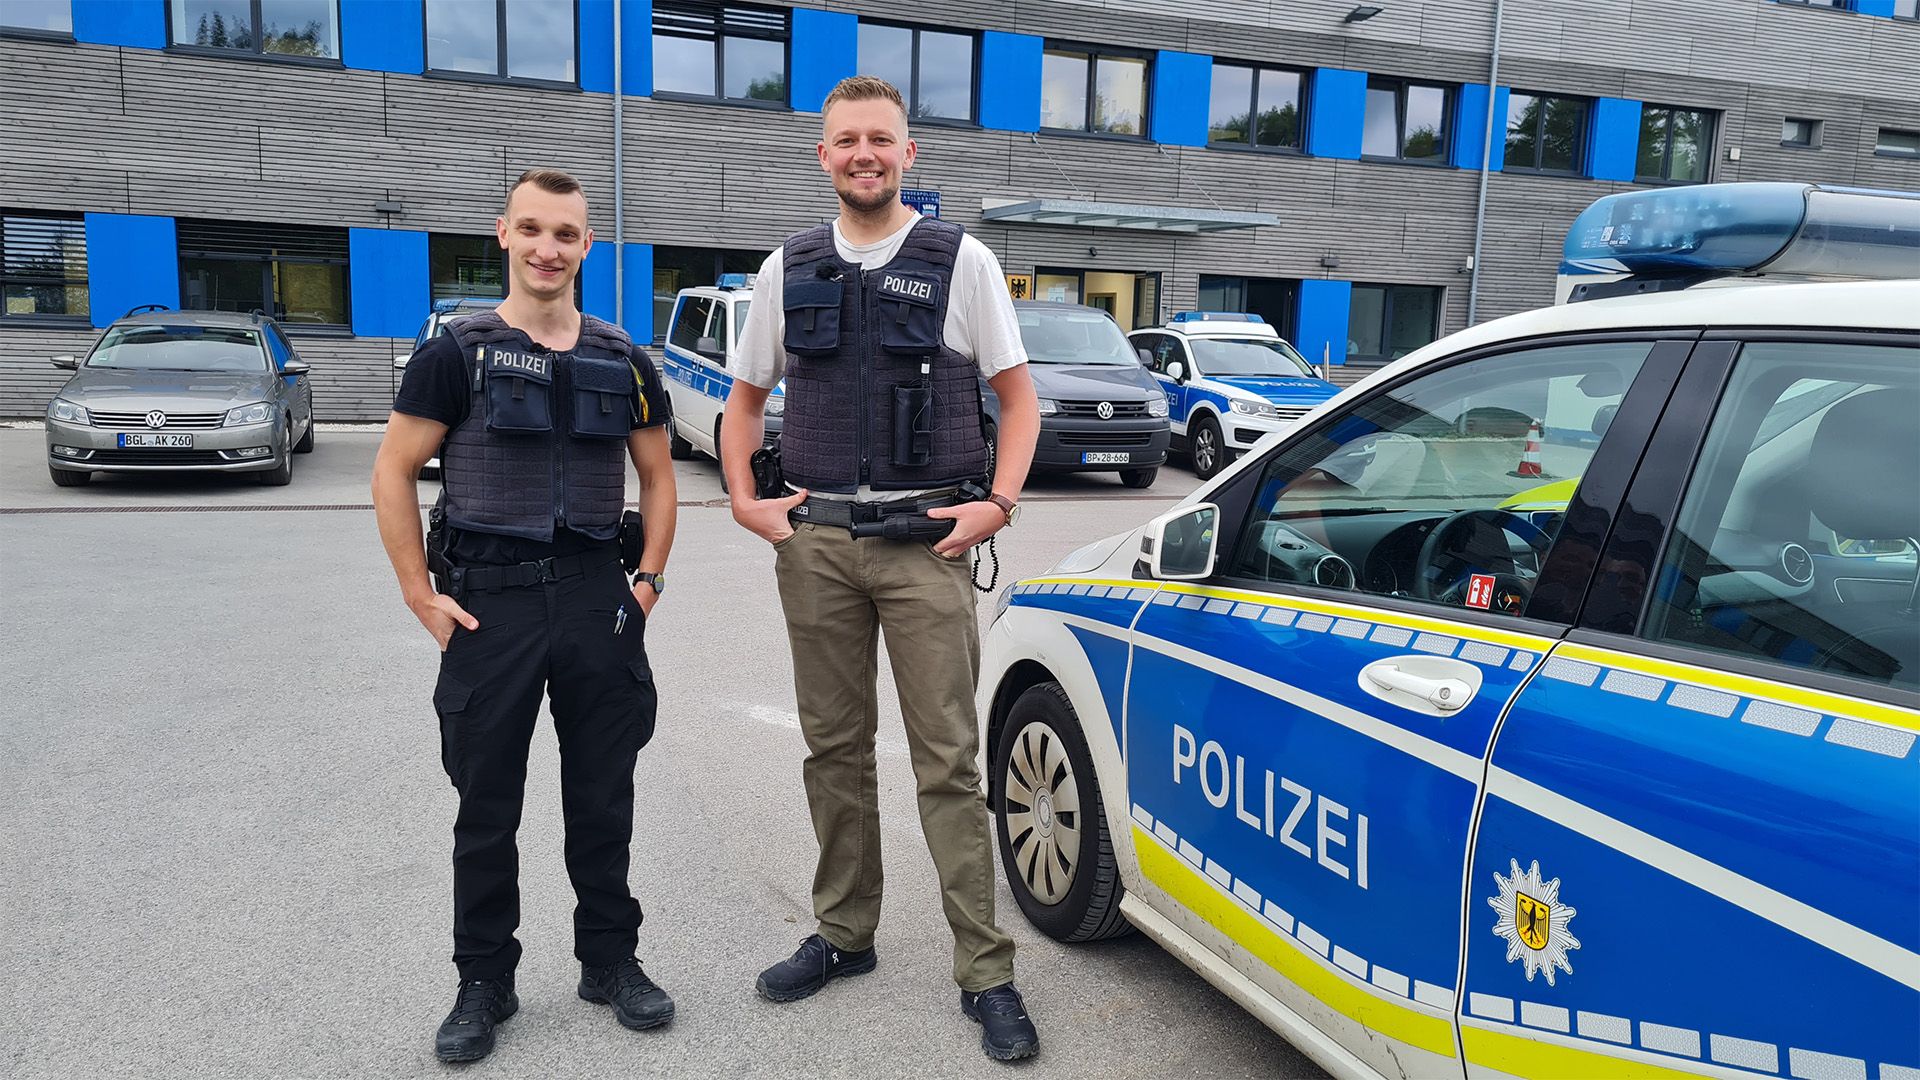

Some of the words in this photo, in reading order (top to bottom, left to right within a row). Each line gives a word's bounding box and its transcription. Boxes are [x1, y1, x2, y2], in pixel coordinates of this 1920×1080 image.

[883, 275, 932, 299] POLIZEI
[493, 350, 546, 374] POLIZEI
[125, 435, 147, 446] BGL
[155, 435, 169, 446] AK
[171, 435, 191, 446] 260
[1086, 453, 1098, 462] BP
[1173, 723, 1369, 890] POLIZEI
